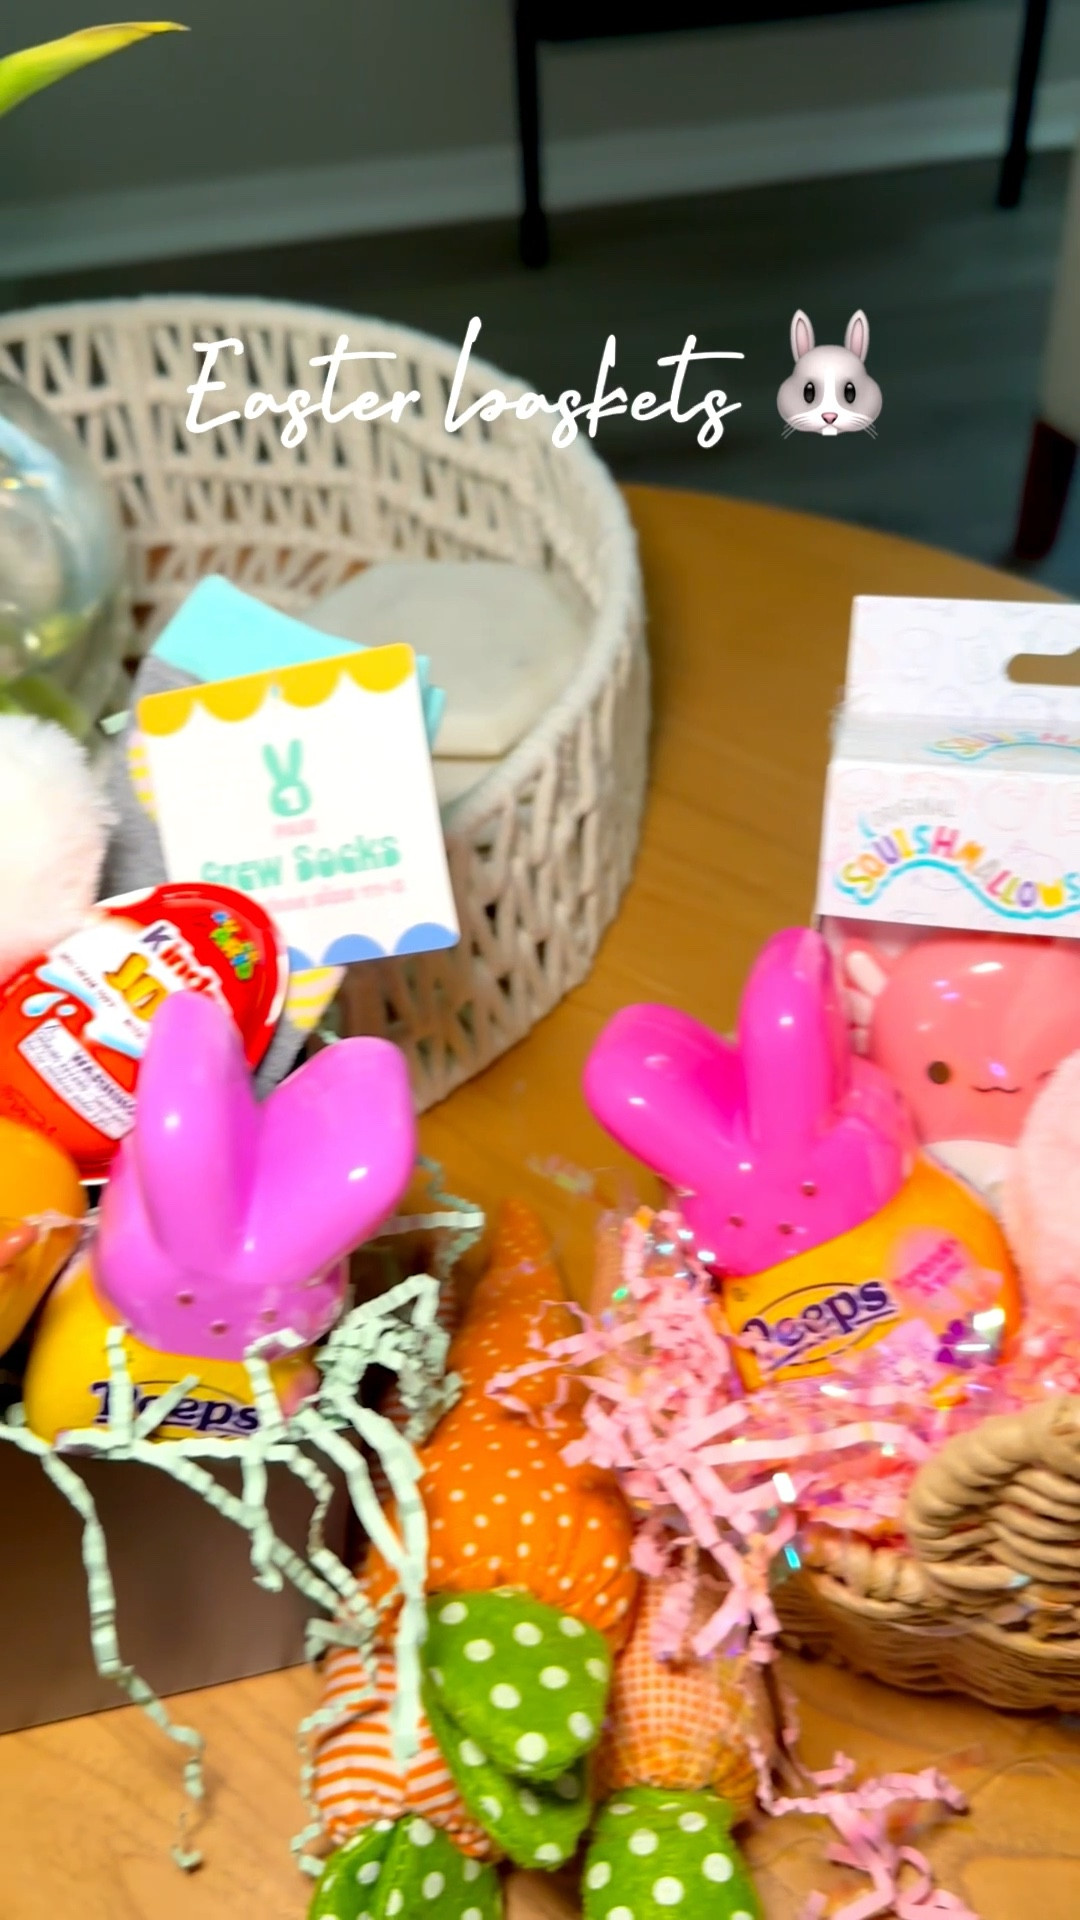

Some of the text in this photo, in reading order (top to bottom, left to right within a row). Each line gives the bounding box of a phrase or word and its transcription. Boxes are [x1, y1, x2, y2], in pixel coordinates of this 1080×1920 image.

[291, 835, 401, 882] Socks
[841, 825, 1080, 907] SQUISHMALLOWS
[102, 952, 169, 1022] Jo
[142, 926, 217, 1000] Kind
